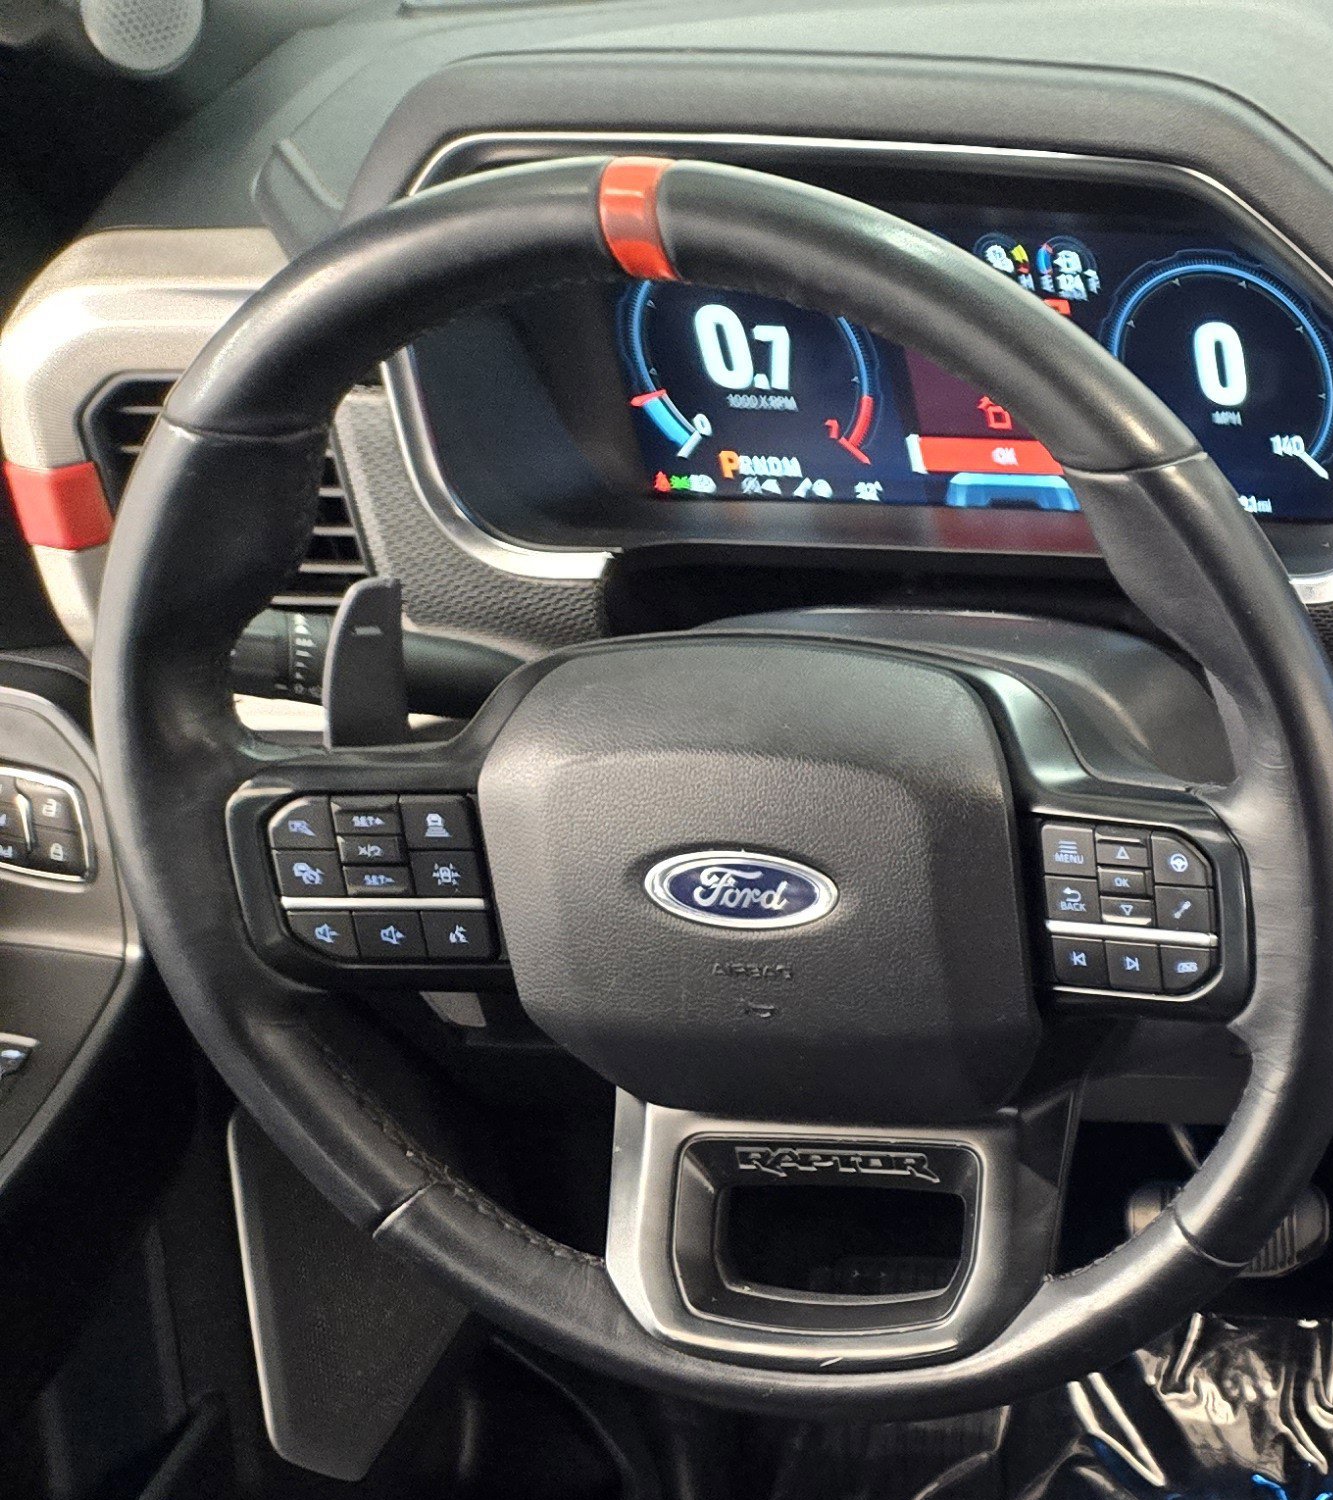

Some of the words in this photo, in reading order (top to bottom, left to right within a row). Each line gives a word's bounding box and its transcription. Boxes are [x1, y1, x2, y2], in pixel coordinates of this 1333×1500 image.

[694, 303, 790, 390] 0.7
[1193, 321, 1248, 407] 0
[1053, 852, 1085, 865] MENU
[693, 866, 790, 911] Ford
[1114, 876, 1131, 888] OK
[1060, 901, 1087, 912] BACK
[733, 1146, 941, 1183] RAPTOR
